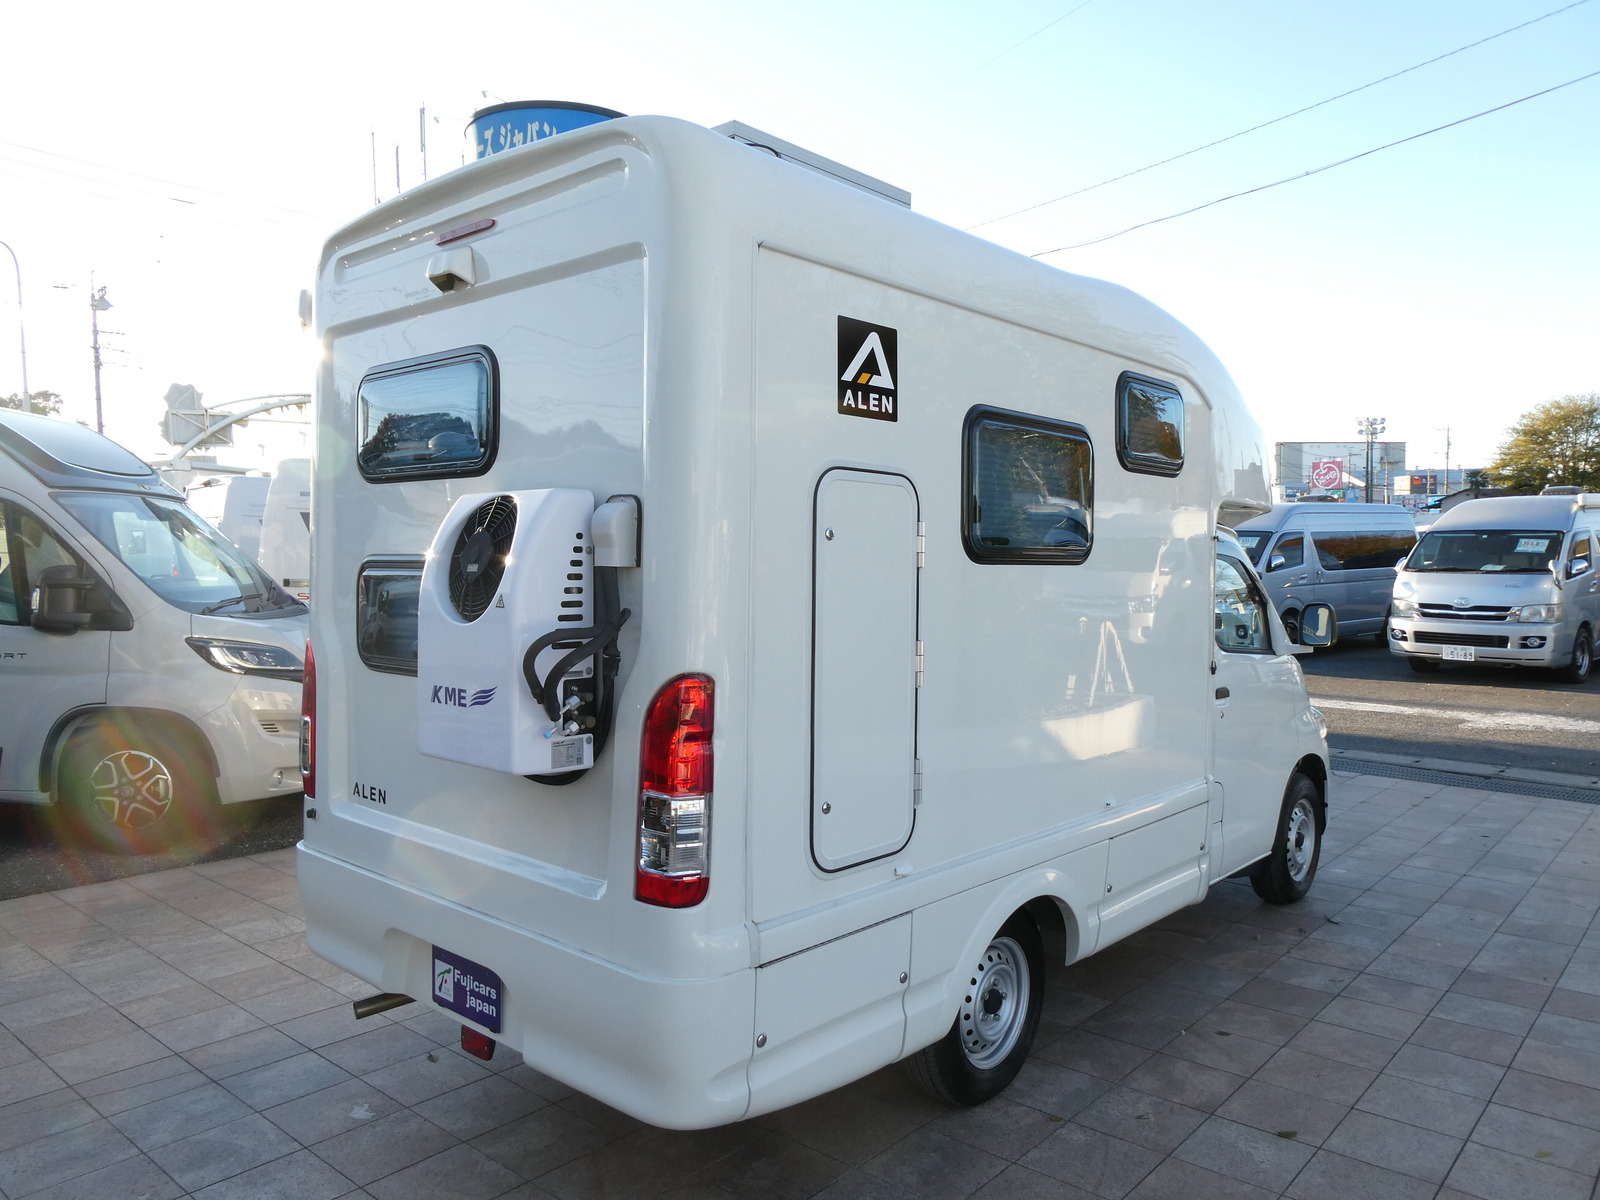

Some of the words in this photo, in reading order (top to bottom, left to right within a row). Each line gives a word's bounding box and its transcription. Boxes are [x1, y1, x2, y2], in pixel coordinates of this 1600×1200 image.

[843, 389, 893, 414] ALEN
[430, 685, 467, 708] KME
[353, 782, 386, 805] ALEN
[454, 969, 497, 1000] Fujicars
